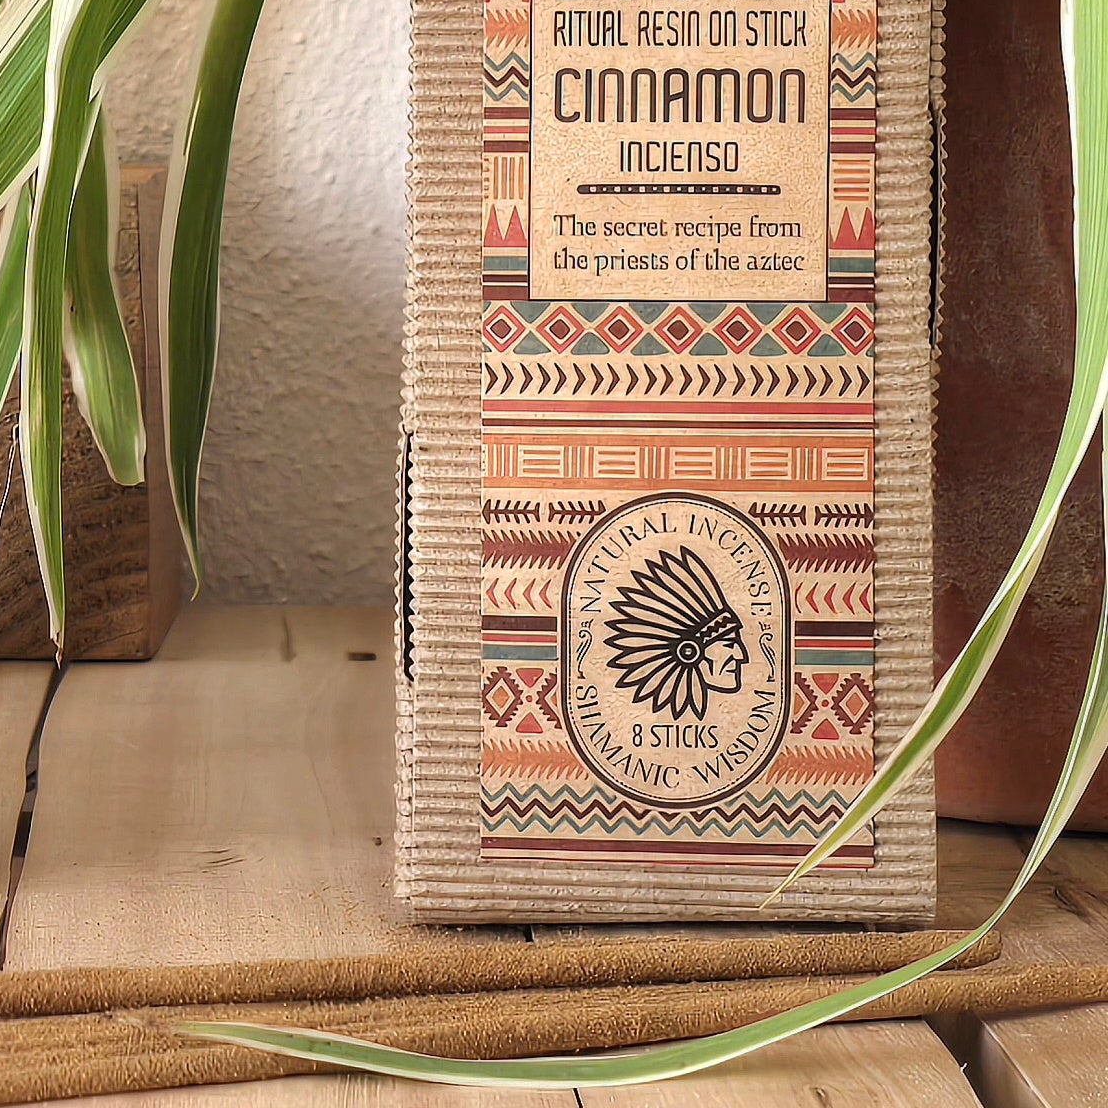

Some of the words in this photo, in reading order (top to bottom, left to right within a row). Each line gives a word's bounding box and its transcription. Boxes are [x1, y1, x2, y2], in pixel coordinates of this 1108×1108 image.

[553, 10, 628, 47] RITUAL
[637, 10, 700, 47] RESIN
[708, 10, 737, 47] ON
[745, 10, 807, 47] STICK
[553, 67, 806, 123] CINNAMON
[620, 140, 739, 172] INCIENSO
[553, 214, 597, 237] The
[603, 214, 667, 237] secret
[674, 215, 742, 244] recipe
[749, 216, 801, 238] from
[553, 247, 589, 270] the
[594, 248, 669, 277] priests
[675, 247, 700, 271] of
[702, 248, 740, 271] the
[747, 249, 805, 271] aztec
[580, 512, 677, 614] NATURAL
[688, 513, 772, 617] INCENSE
[576, 685, 680, 790] SHAMANIC
[692, 689, 776, 786] WISDOM
[632, 724, 643, 748] 8
[650, 724, 719, 748] STICKS
